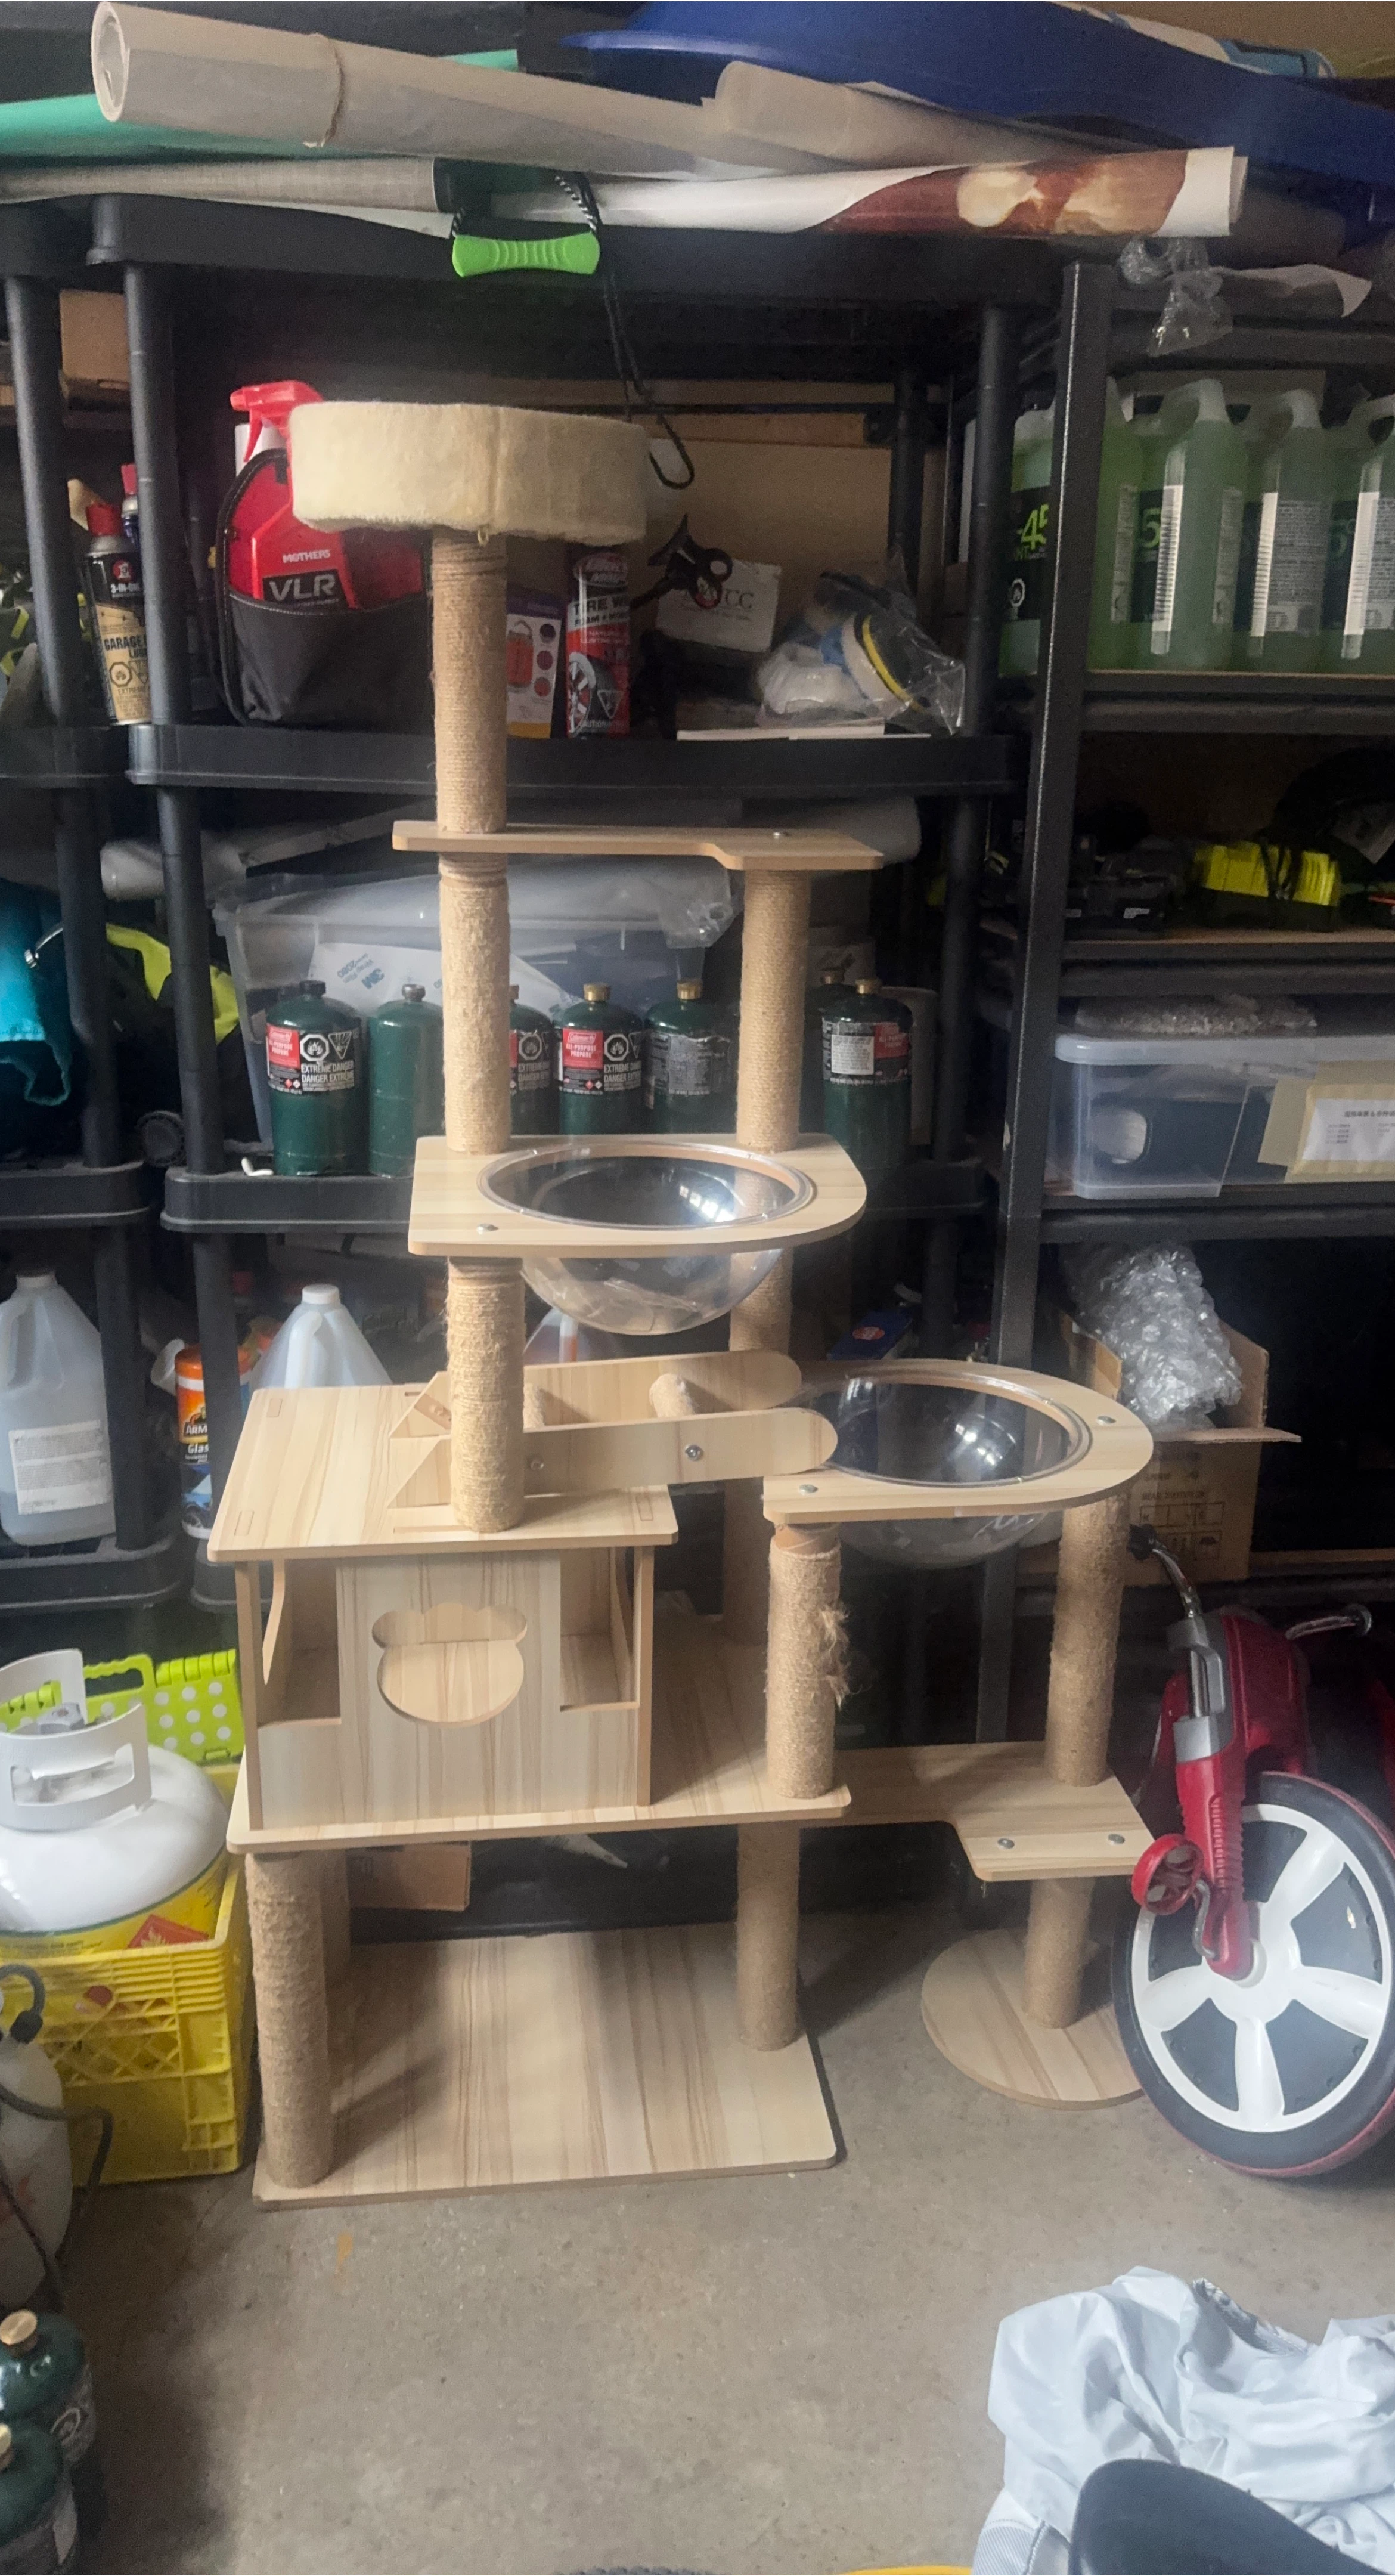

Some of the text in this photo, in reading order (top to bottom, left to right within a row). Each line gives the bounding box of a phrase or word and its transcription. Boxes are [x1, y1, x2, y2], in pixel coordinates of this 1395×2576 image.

[283, 549, 331, 564] MOTHERS
[269, 574, 336, 602] VLR
[104, 634, 141, 651] GARAGE
[301, 1064, 331, 1073] EXTREME
[604, 1063, 629, 1073] EXTREME
[302, 1073, 328, 1083] DANGER
[604, 1073, 627, 1083] DANGER
